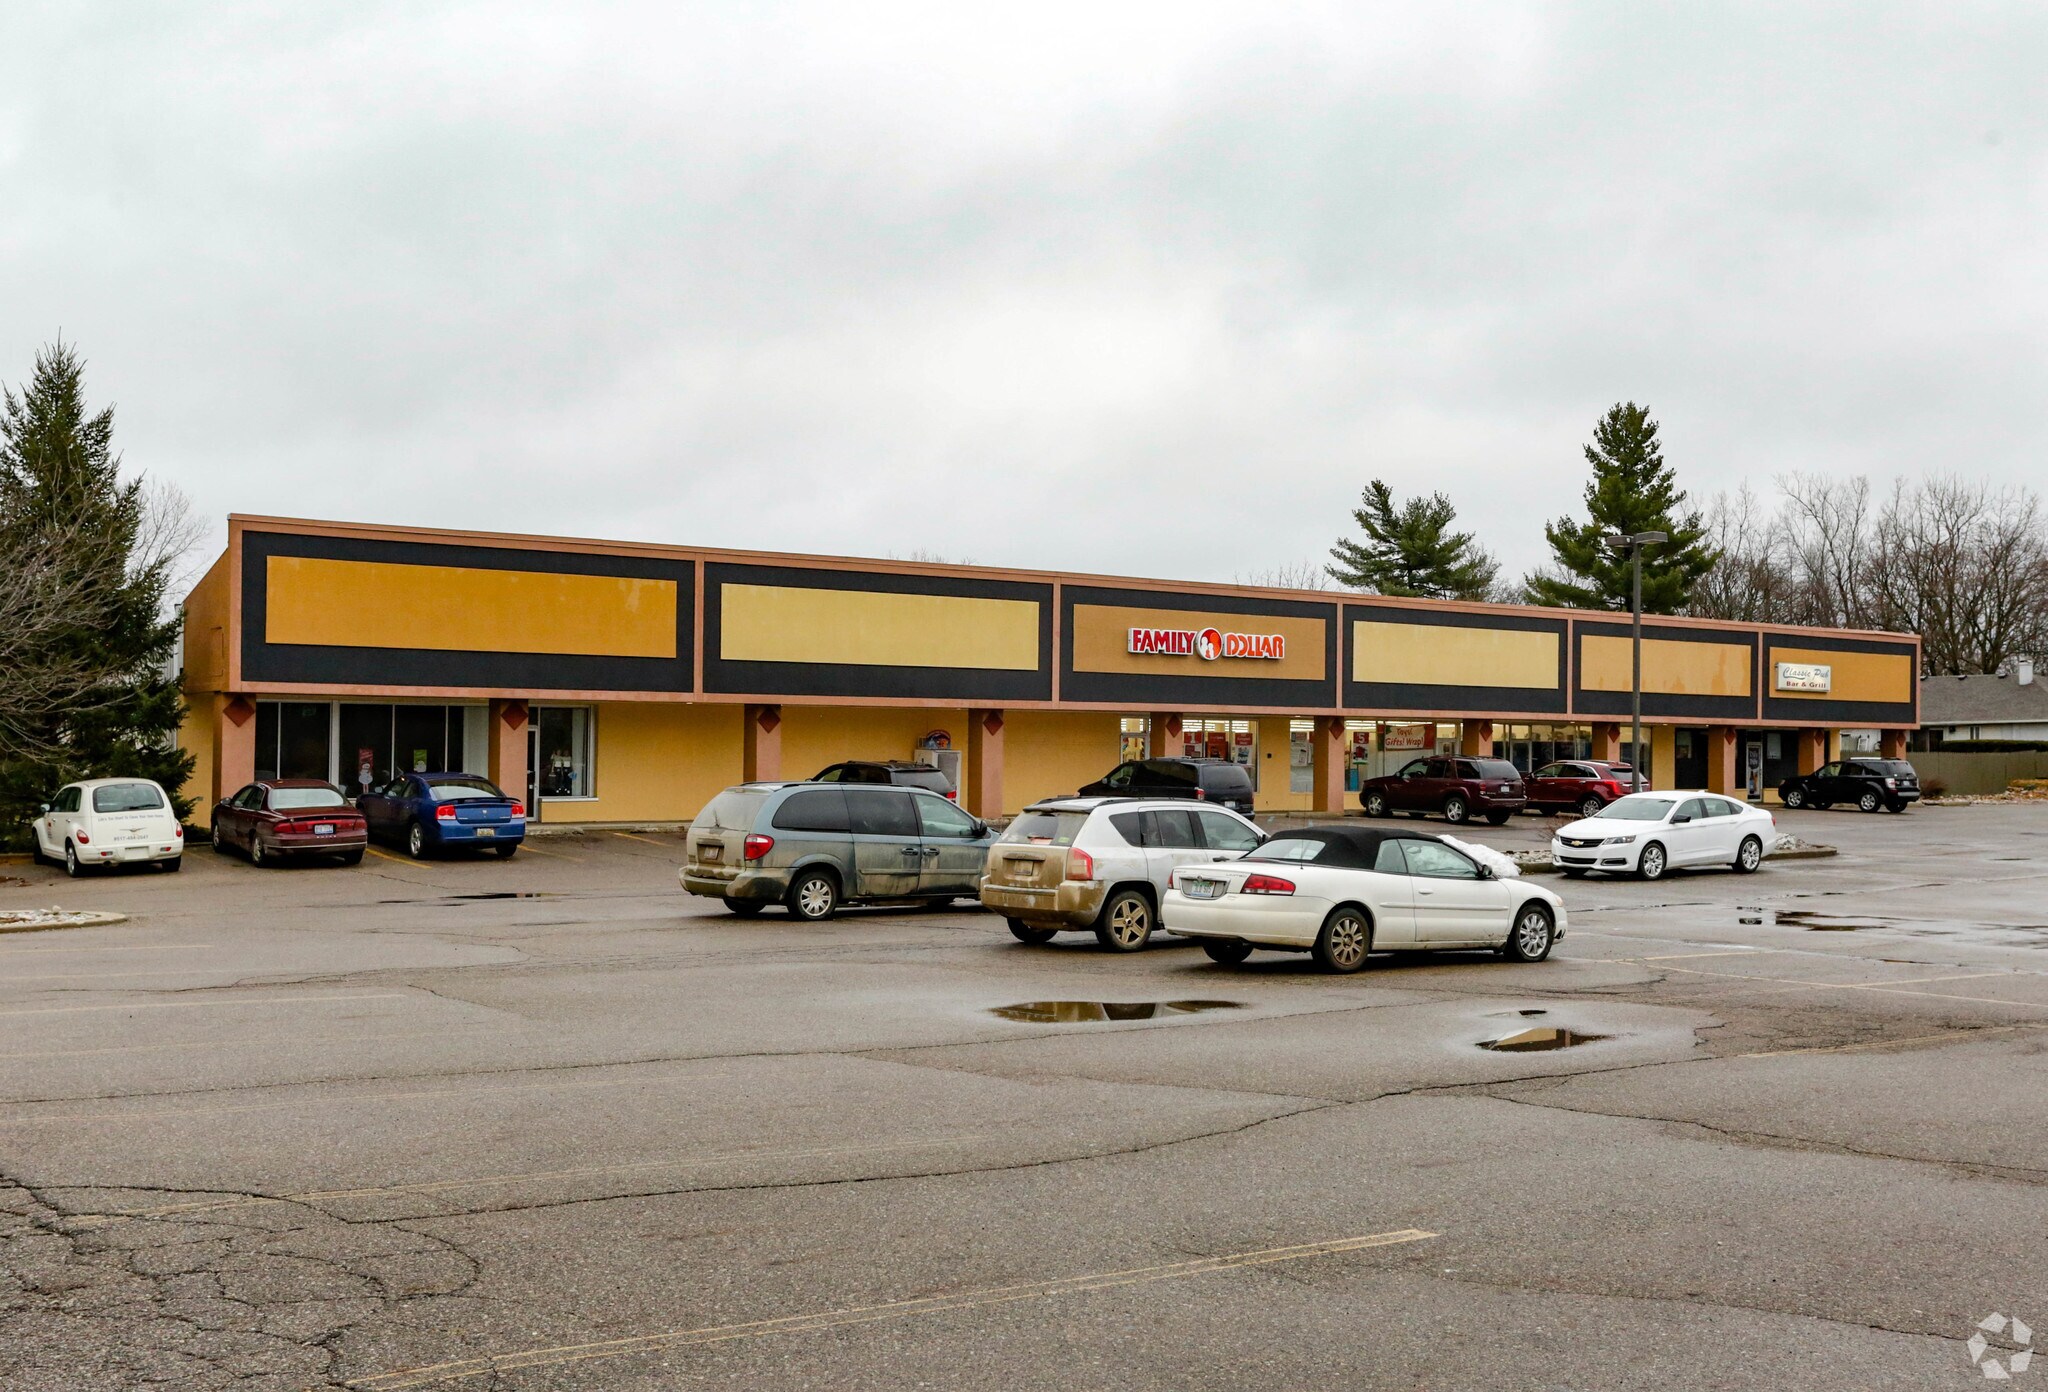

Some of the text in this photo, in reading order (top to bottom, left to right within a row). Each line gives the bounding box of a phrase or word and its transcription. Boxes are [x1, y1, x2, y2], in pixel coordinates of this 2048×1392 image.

[1132, 629, 1284, 658] FAMILY DOLLAR
[1783, 666, 1829, 680] Classic Pub
[1385, 737, 1424, 747] Gifts! Wrap!
